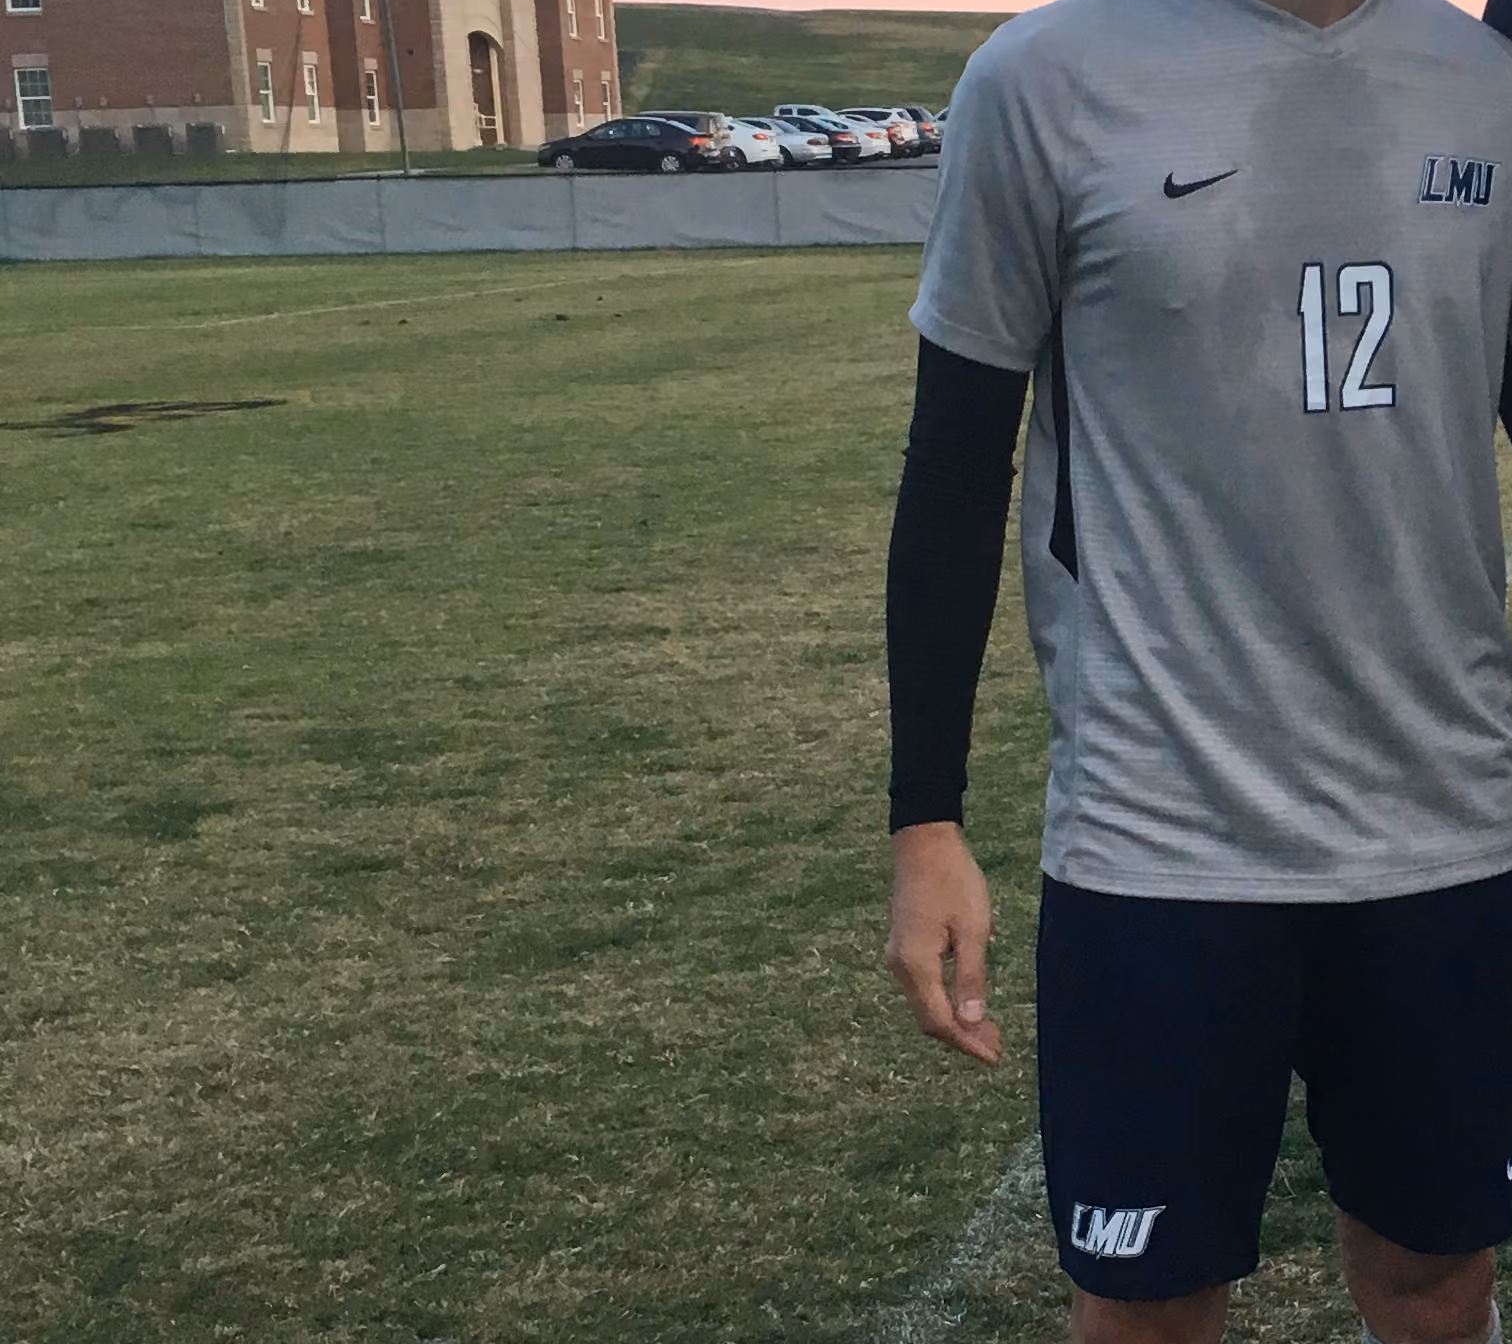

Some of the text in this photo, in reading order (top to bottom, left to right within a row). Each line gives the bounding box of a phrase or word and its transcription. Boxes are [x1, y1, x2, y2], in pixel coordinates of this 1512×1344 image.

[1418, 154, 1501, 207] LMU
[1297, 260, 1396, 414] 12
[1071, 1201, 1167, 1260] LMU
